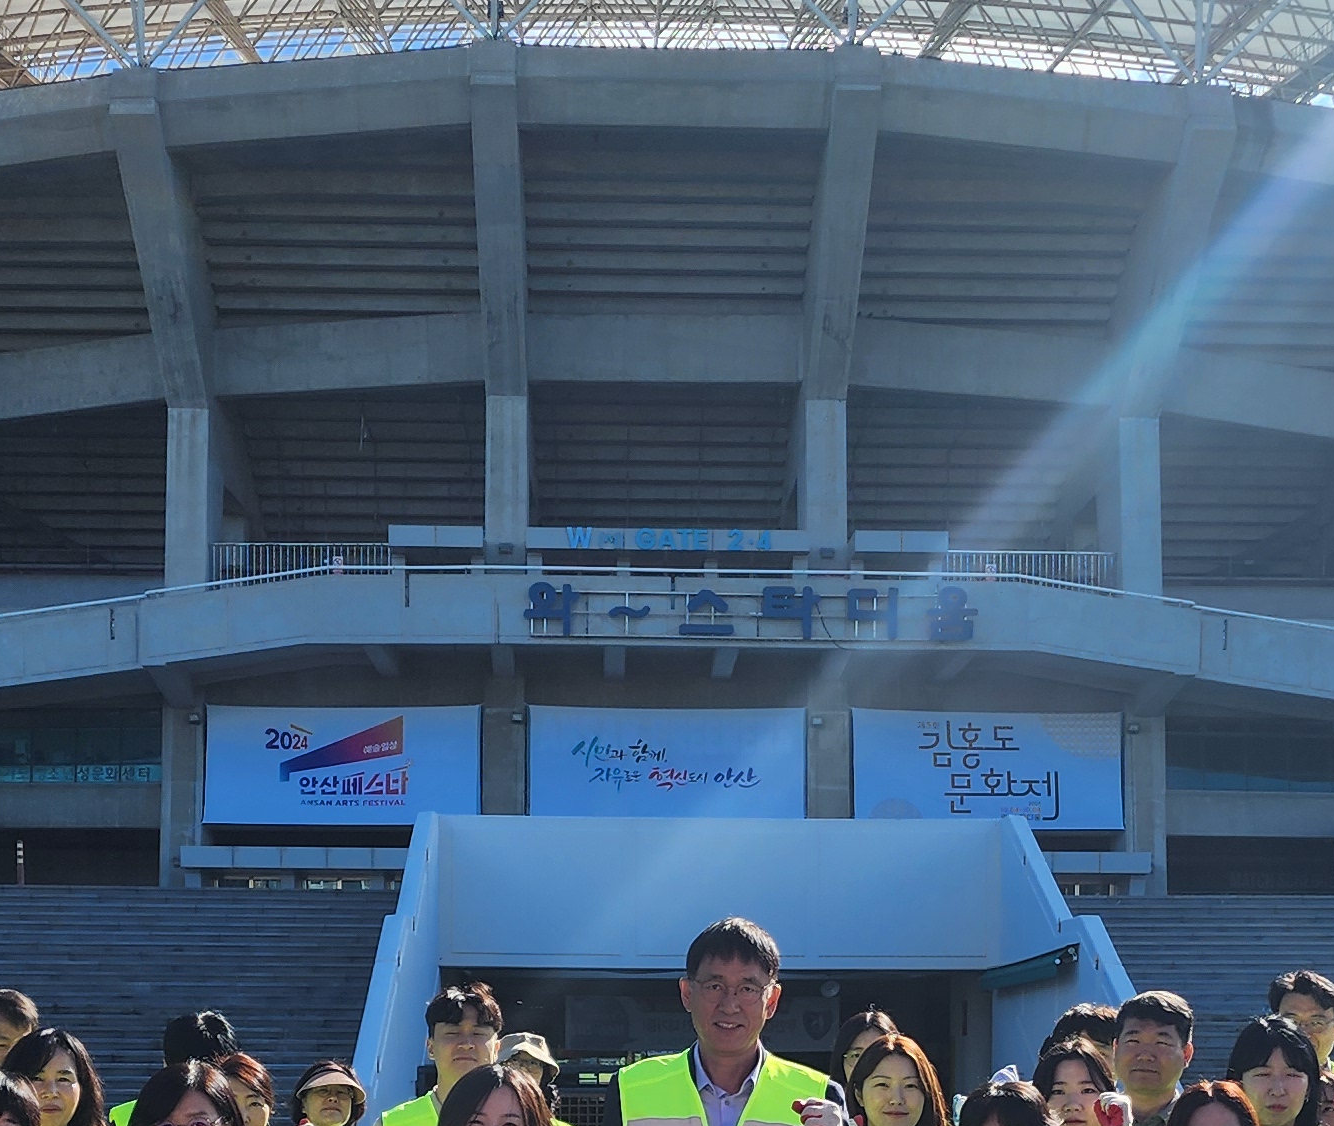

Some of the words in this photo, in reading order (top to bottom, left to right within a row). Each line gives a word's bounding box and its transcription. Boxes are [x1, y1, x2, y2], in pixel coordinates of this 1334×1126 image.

[566, 526, 592, 549] W
[634, 527, 709, 551] GATE
[264, 728, 309, 750] 2024
[571, 736, 628, 767] 시민과
[918, 720, 1020, 770] 김홍도
[588, 766, 642, 793] 자유로운
[648, 767, 709, 792] 혁신도시
[713, 766, 762, 789] 안산
[300, 799, 333, 807] ANSAN
[335, 799, 360, 807] ARTS
[362, 799, 406, 807] FESTIVAL
[943, 767, 1060, 821] 문화제
